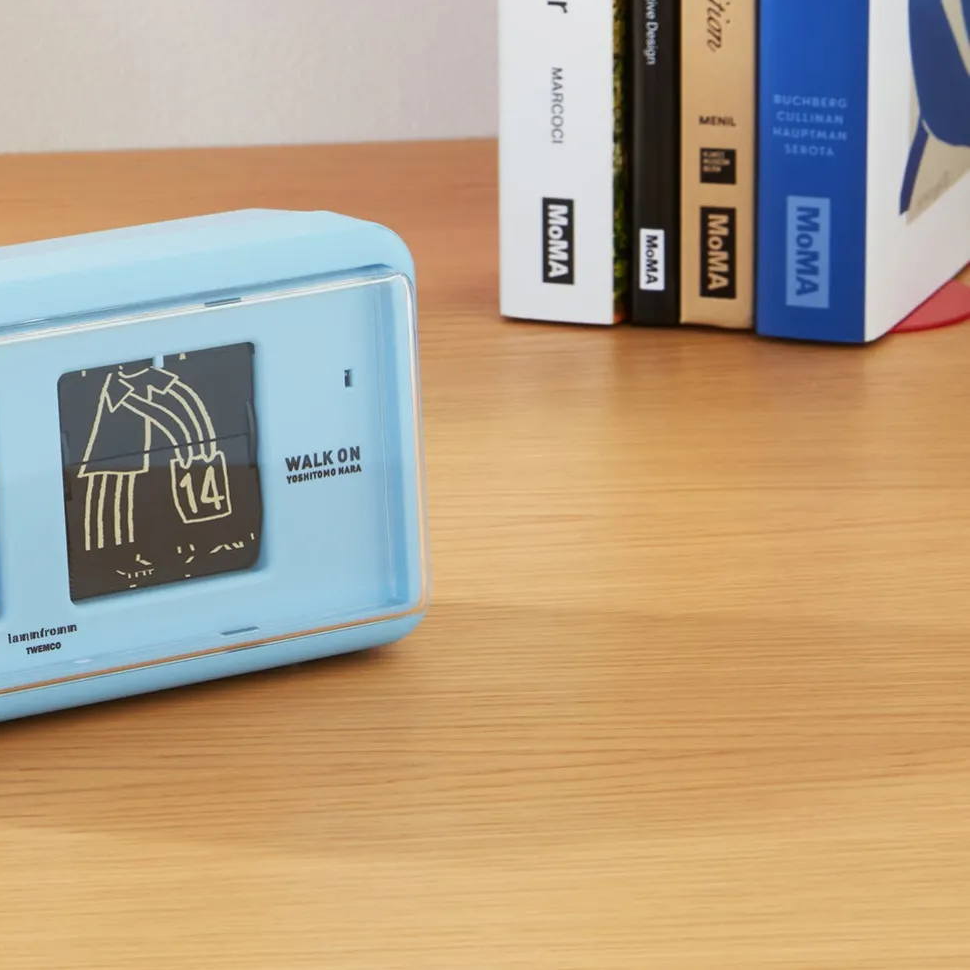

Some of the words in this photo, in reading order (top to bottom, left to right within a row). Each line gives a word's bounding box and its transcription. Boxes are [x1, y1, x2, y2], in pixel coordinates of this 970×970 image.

[644, 22, 659, 66] Design
[551, 67, 563, 144] MARCOCI
[773, 94, 847, 108] BUCHBERG
[699, 116, 736, 127] MENIL
[775, 110, 844, 125] CULLINAN
[772, 126, 848, 141] HAUPTMAN
[784, 143, 835, 156] SEROTA
[547, 204, 568, 278] MoMA
[707, 214, 730, 291] MoMA
[795, 206, 820, 297] MoMA
[644, 234, 659, 285] MoMA
[285, 449, 334, 472] WALK
[337, 446, 361, 463] ON
[286, 468, 336, 484] YOSHITOMO
[338, 464, 362, 476] NARA
[180, 465, 225, 514] 14
[26, 641, 62, 655] TWEMCO
